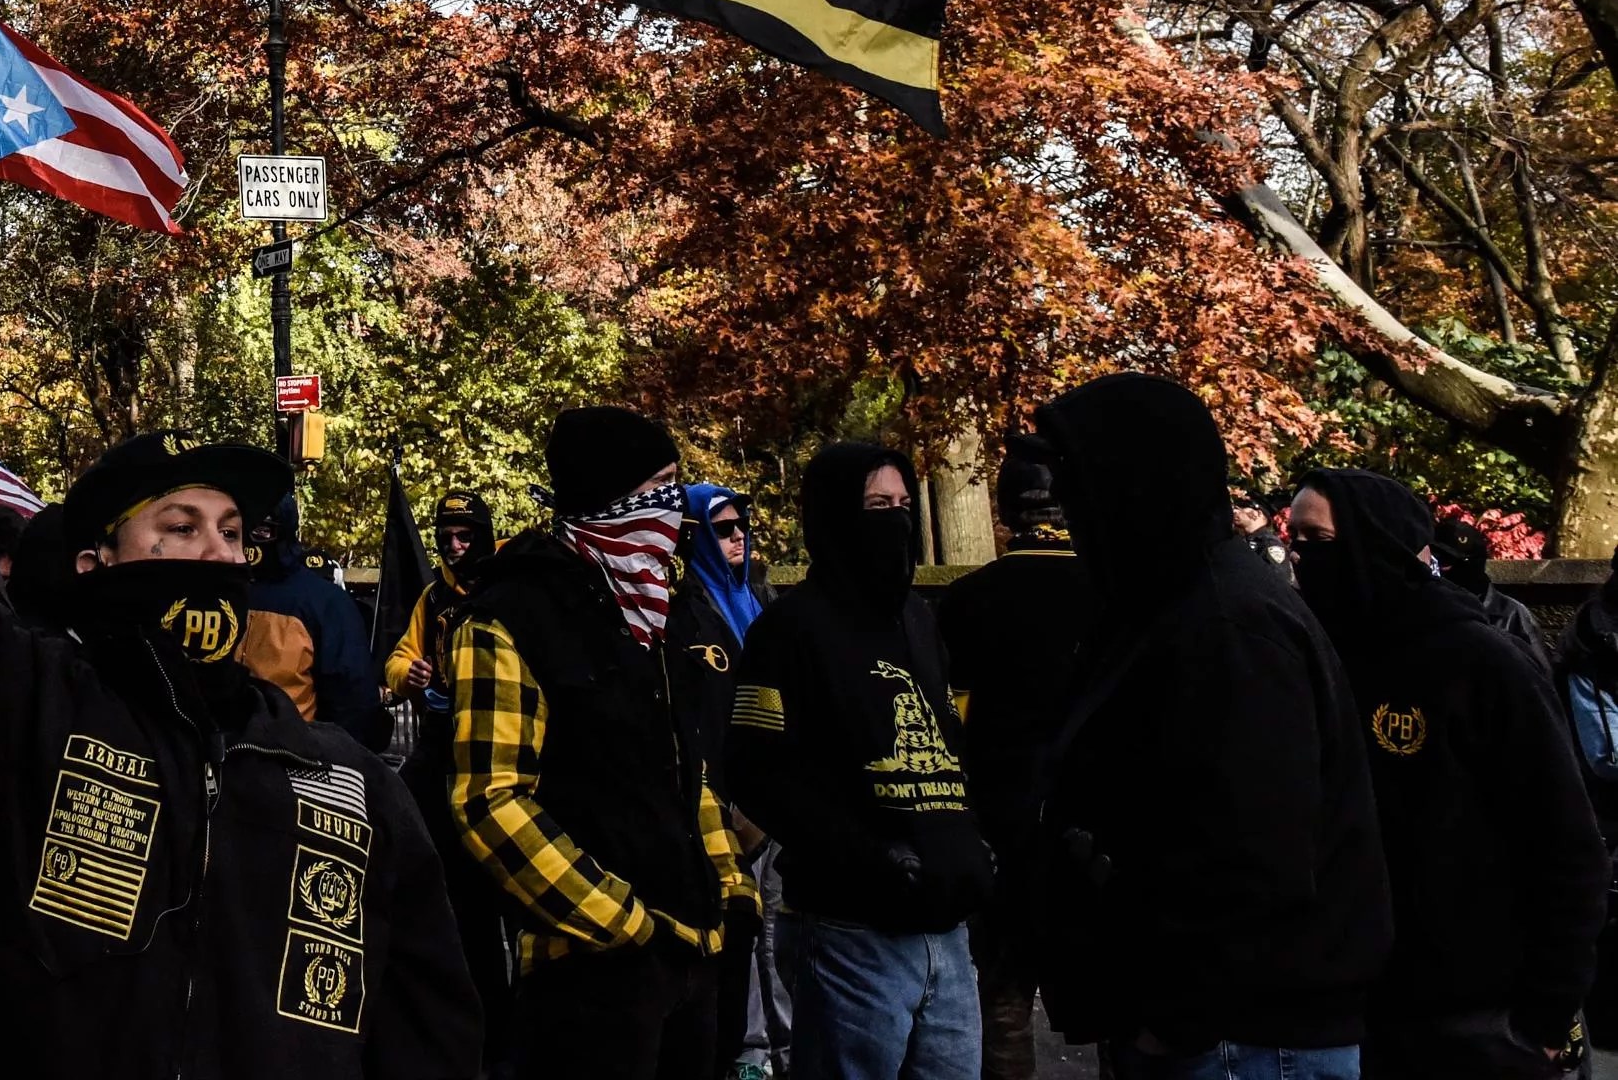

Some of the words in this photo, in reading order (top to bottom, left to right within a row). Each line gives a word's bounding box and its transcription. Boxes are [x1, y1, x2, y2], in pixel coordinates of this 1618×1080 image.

[245, 165, 320, 185] PASSENGER
[247, 189, 280, 207] CARS
[289, 191, 320, 208] ONLY
[259, 254, 270, 269] ONE
[275, 250, 288, 264] WAY
[287, 379, 312, 387] STOPPING
[183, 609, 221, 650] PB
[1388, 713, 1413, 739] PB
[84, 743, 147, 777] AZREAL
[83, 782, 88, 792] I
[89, 786, 101, 796] AM
[103, 789, 108, 798] A
[111, 792, 133, 807] PROUD
[874, 783, 916, 798] DON'T
[918, 782, 951, 797] TREAD
[951, 782, 965, 797] ON
[66, 788, 101, 806] WESTERN
[103, 800, 146, 821] CHAUVINIST
[72, 801, 90, 814] WHO
[92, 807, 123, 825] REFUSES
[125, 818, 134, 828] TO
[54, 809, 93, 826] APOLOGIZE
[95, 820, 109, 832] FOR
[111, 825, 148, 844] CREATING
[61, 821, 75, 834] THE
[77, 825, 108, 844] MODERN
[110, 836, 136, 851] WORLD
[314, 810, 361, 843] UHURU
[53, 852, 69, 870] PB
[304, 943, 331, 954] STAND
[334, 947, 351, 966] BACK
[316, 966, 335, 991] PB
[298, 1001, 327, 1020] STAND
[331, 1010, 341, 1021] BY
